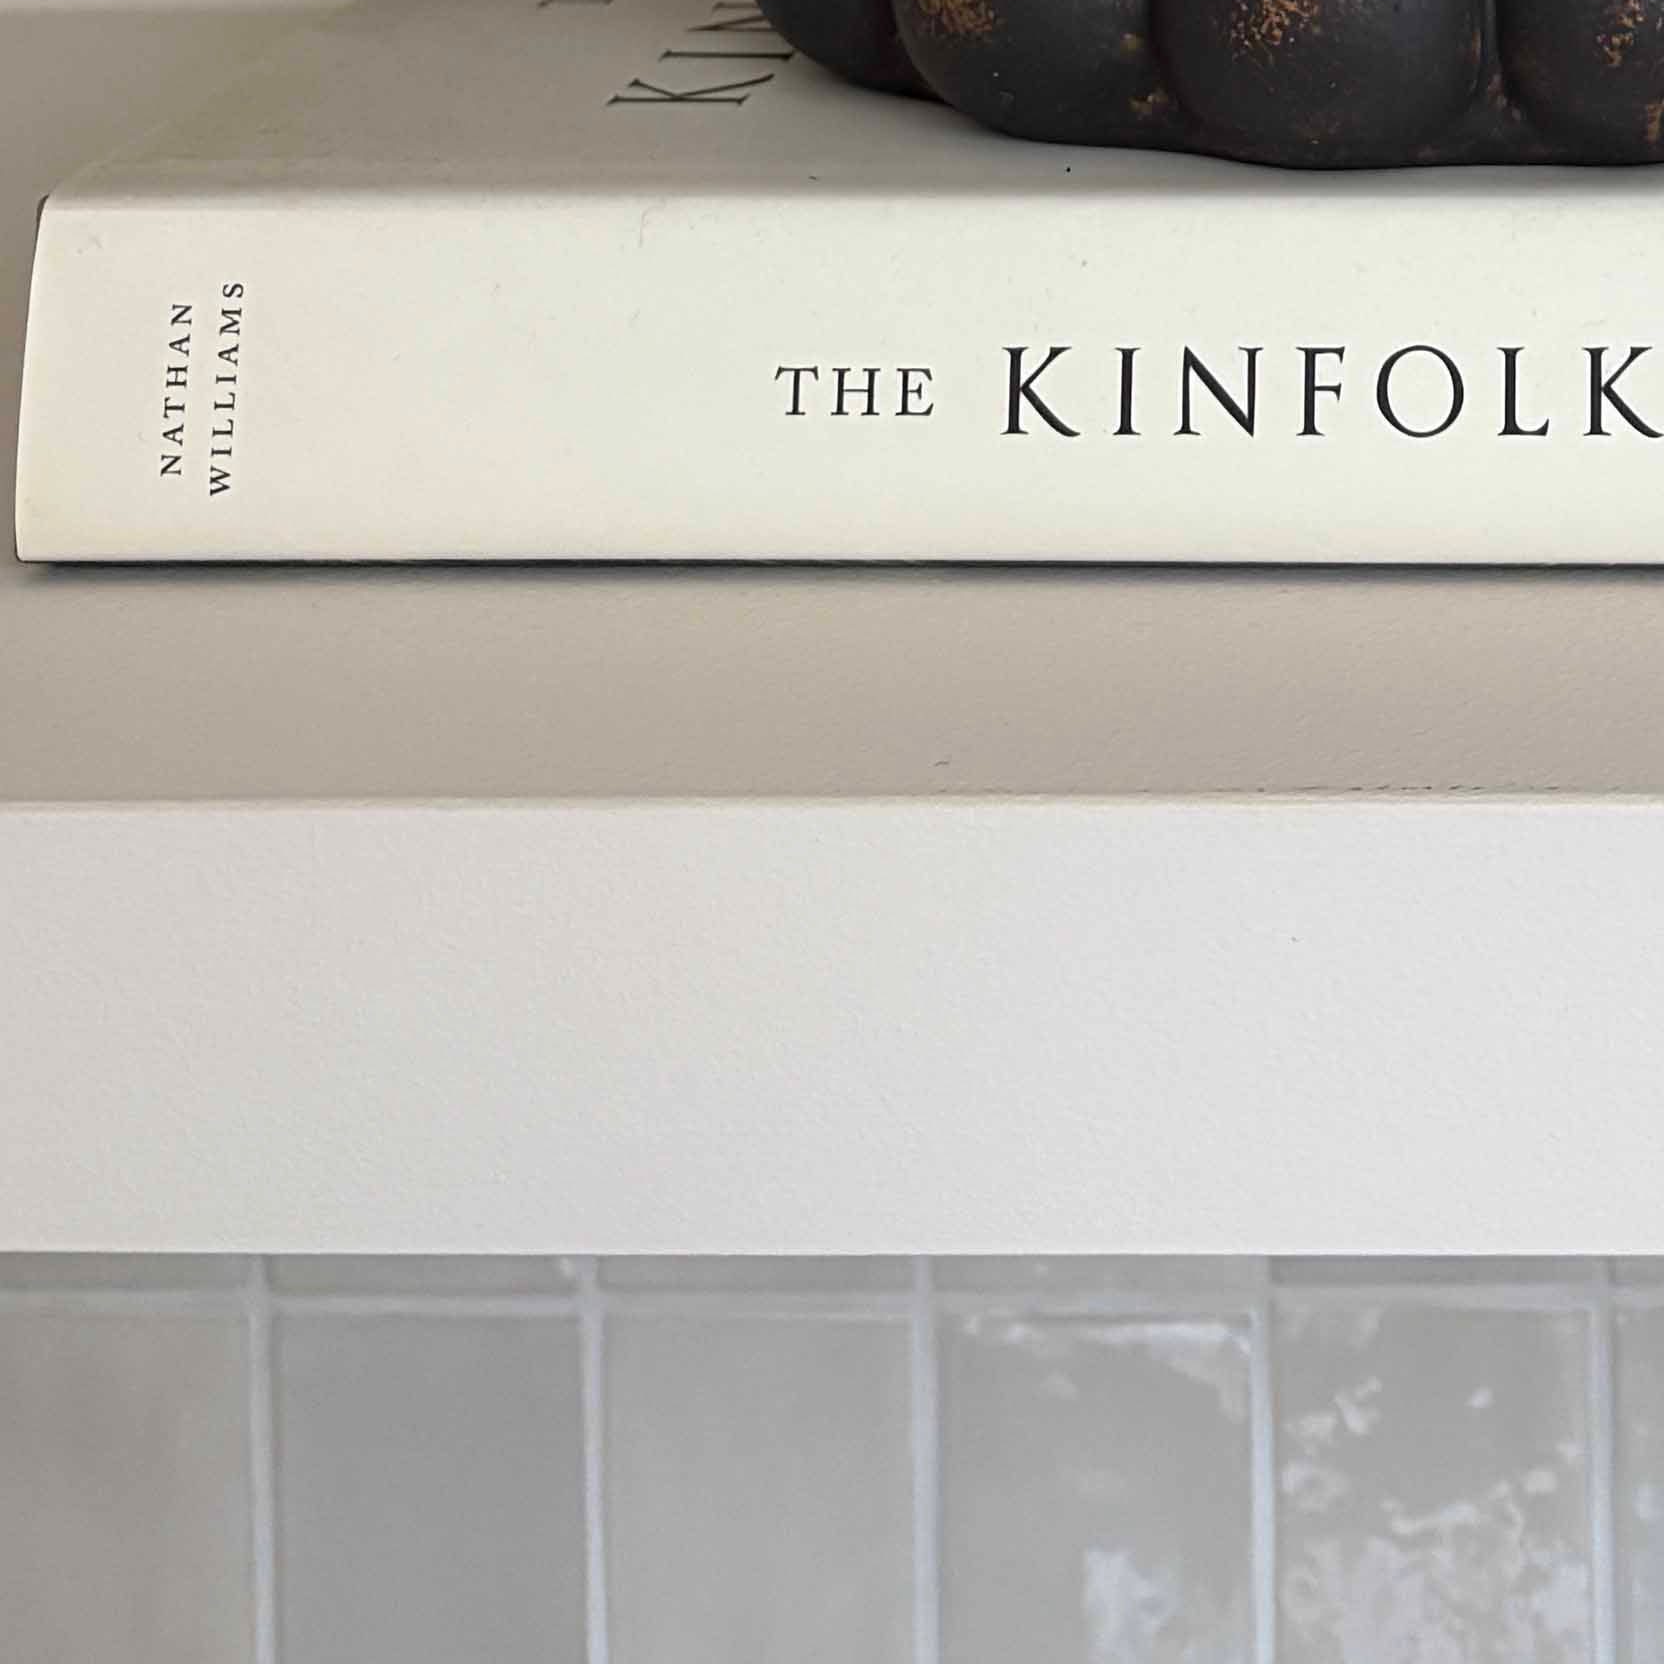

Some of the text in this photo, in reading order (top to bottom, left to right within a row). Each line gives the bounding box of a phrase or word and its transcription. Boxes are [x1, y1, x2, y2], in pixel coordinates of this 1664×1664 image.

[160, 303, 193, 477] NATHAN
[209, 282, 244, 497] WILLIAMS
[774, 365, 935, 418] THE
[1000, 343, 1664, 440] KINFOLK
